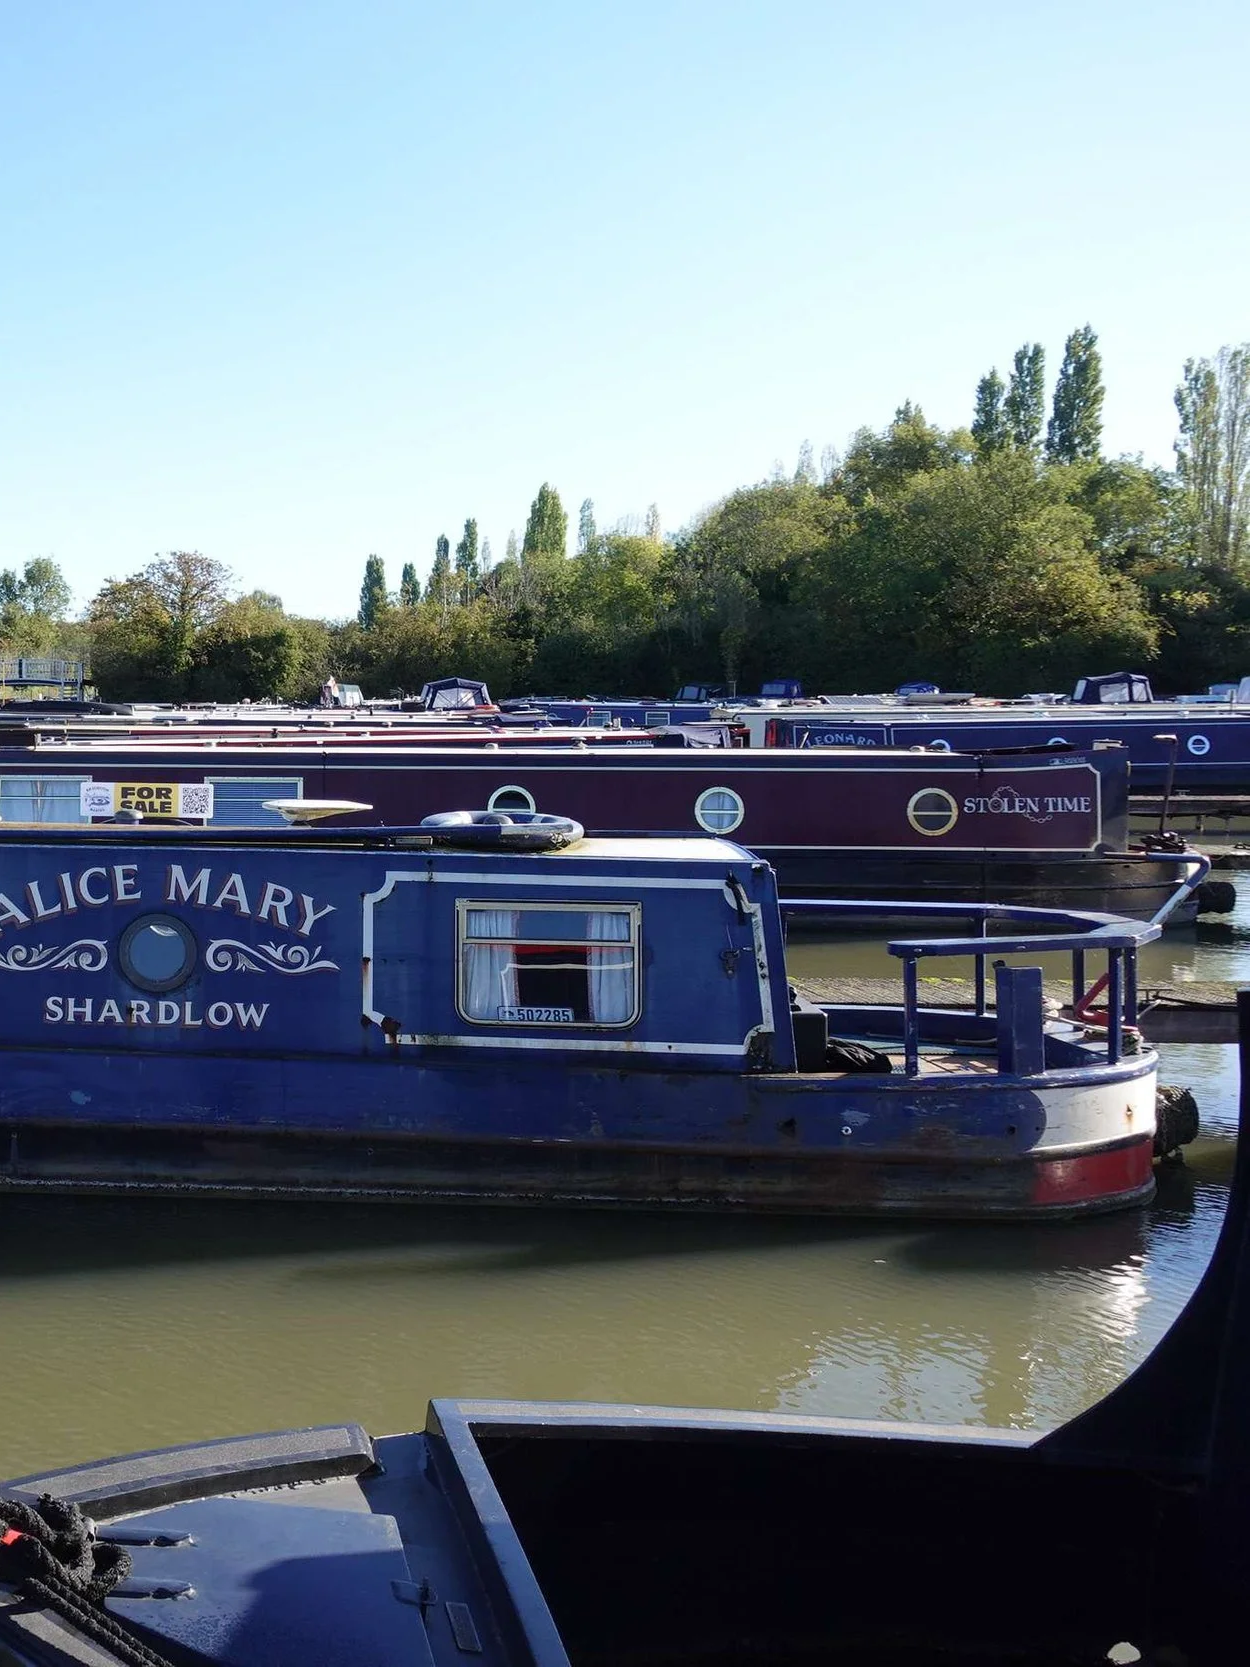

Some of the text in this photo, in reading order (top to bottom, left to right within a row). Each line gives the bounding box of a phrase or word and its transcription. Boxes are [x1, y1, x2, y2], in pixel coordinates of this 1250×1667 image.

[121, 787, 173, 799] FOR
[120, 800, 172, 813] SALE
[963, 796, 1092, 813] STOLEN TIME
[166, 864, 338, 937] MARY
[45, 996, 270, 1030] SHARDLOW
[517, 1008, 570, 1022] 502285
